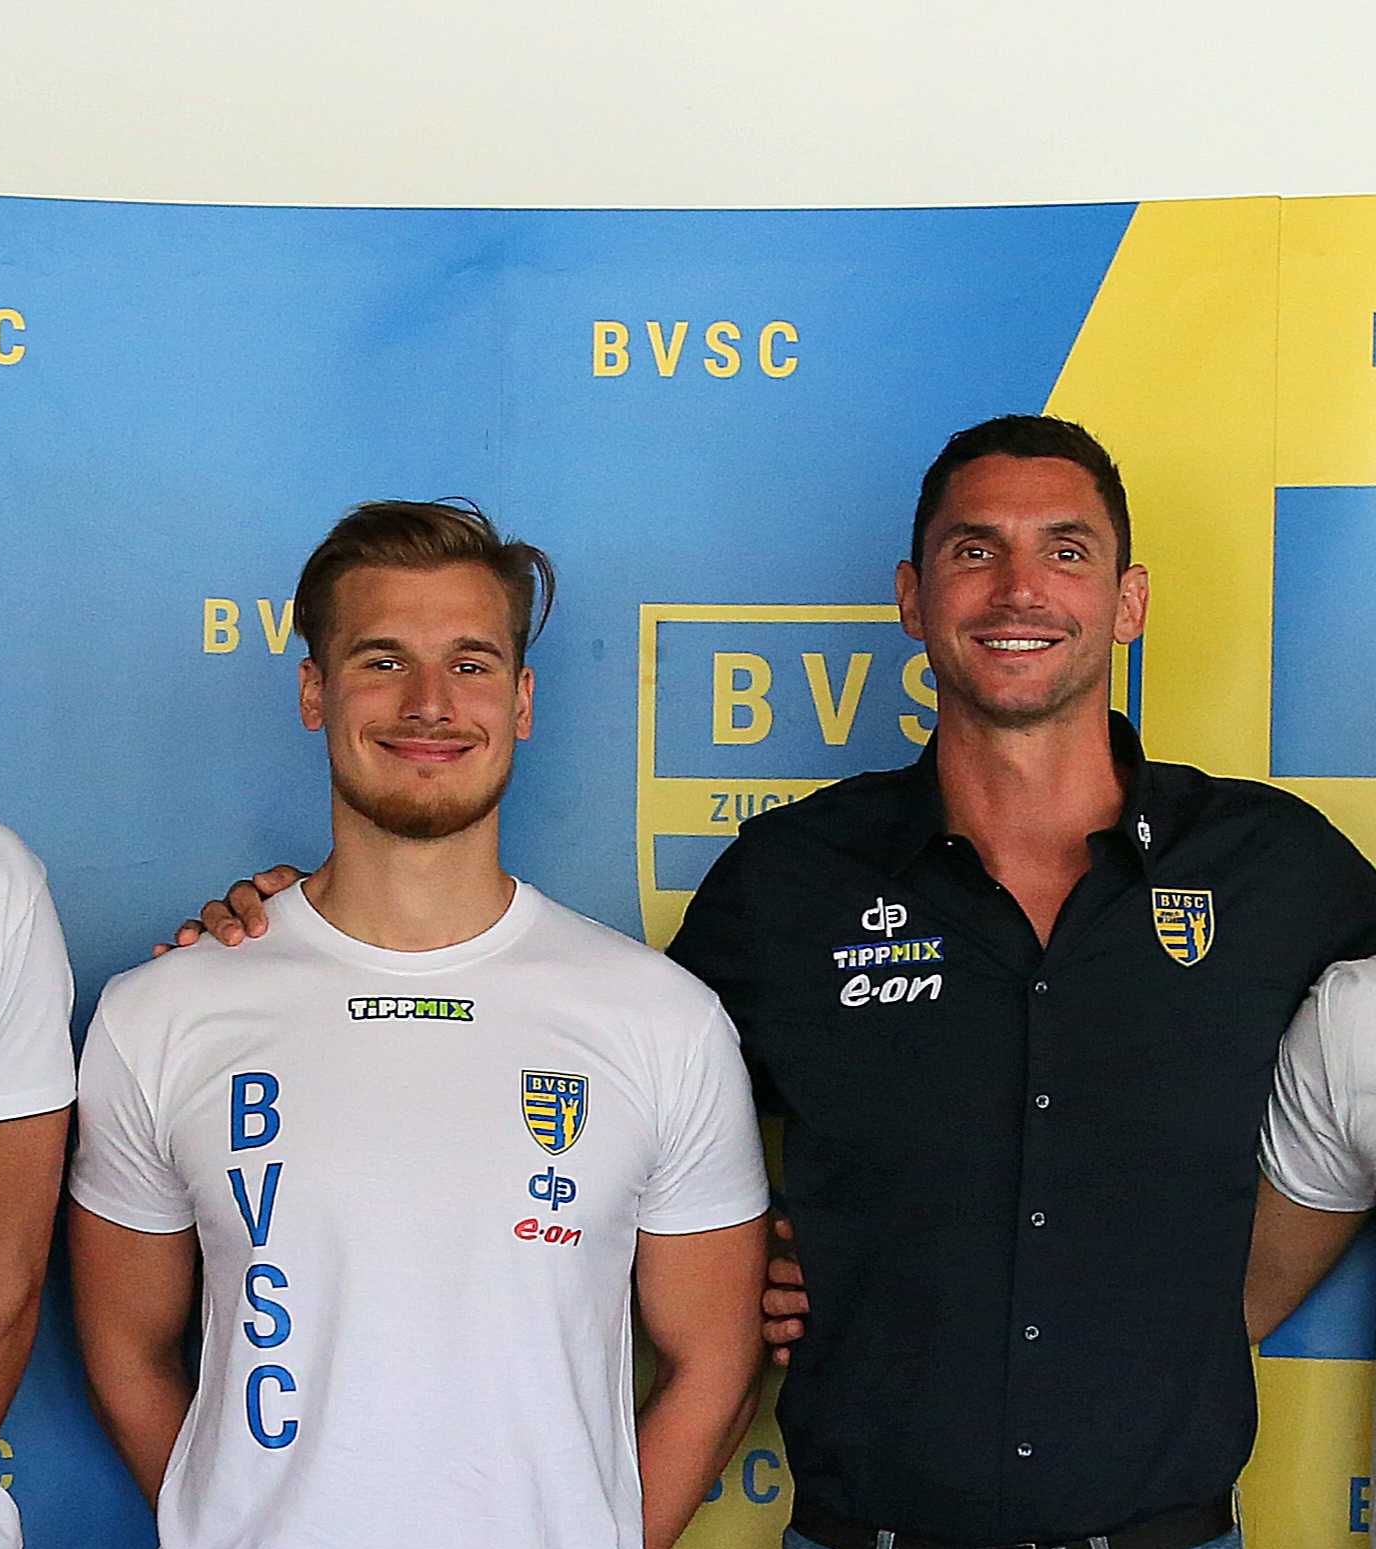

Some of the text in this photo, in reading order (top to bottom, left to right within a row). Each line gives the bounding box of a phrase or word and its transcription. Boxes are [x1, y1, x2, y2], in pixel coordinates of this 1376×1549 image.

[592, 321, 799, 378] BVSC
[203, 598, 295, 654] BV
[711, 652, 936, 746] BVS
[1160, 895, 1204, 908] BVSC
[532, 1077, 580, 1095] BVSC
[226, 1072, 300, 1450] BVSC
